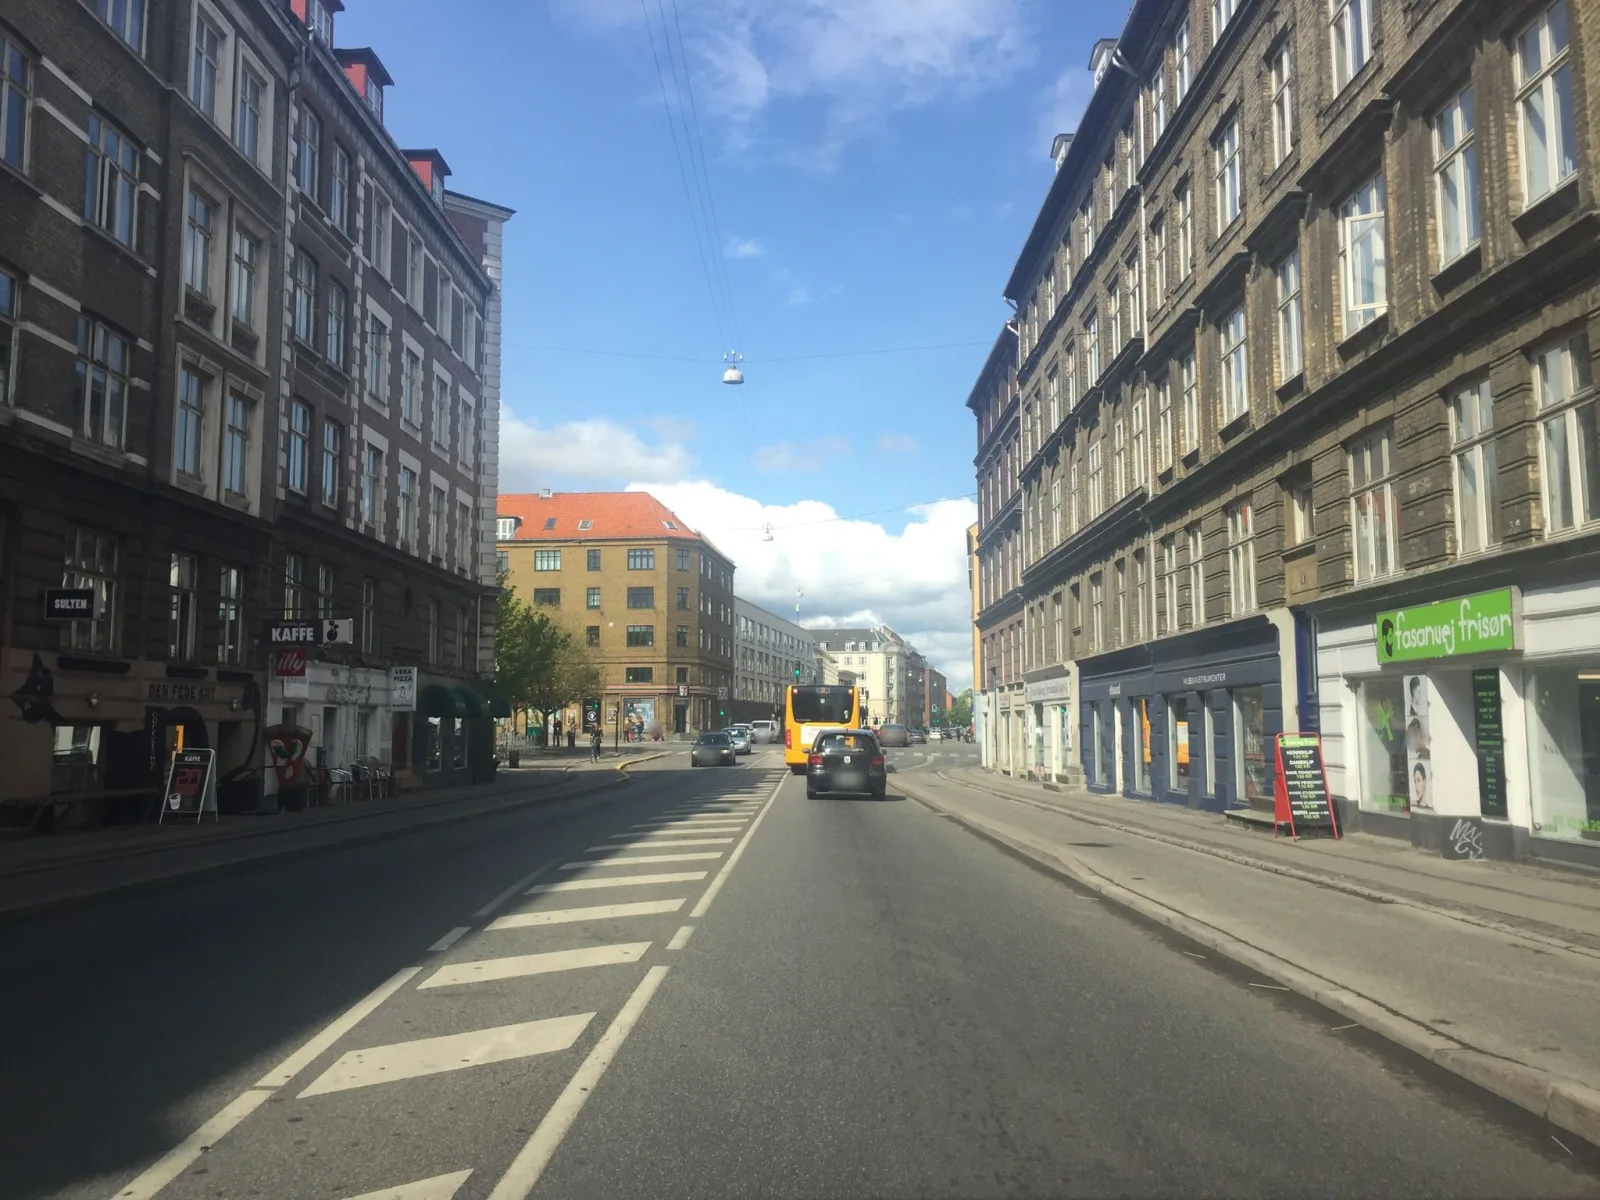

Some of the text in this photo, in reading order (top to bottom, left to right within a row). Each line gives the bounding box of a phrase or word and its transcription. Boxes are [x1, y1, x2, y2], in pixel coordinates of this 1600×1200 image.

[54, 598, 88, 609] SULTEN
[1459, 599, 1511, 643] frisør
[272, 627, 314, 642] KAFFE
[277, 651, 304, 676] illy
[149, 684, 216, 700] DEN FEDE KAT
